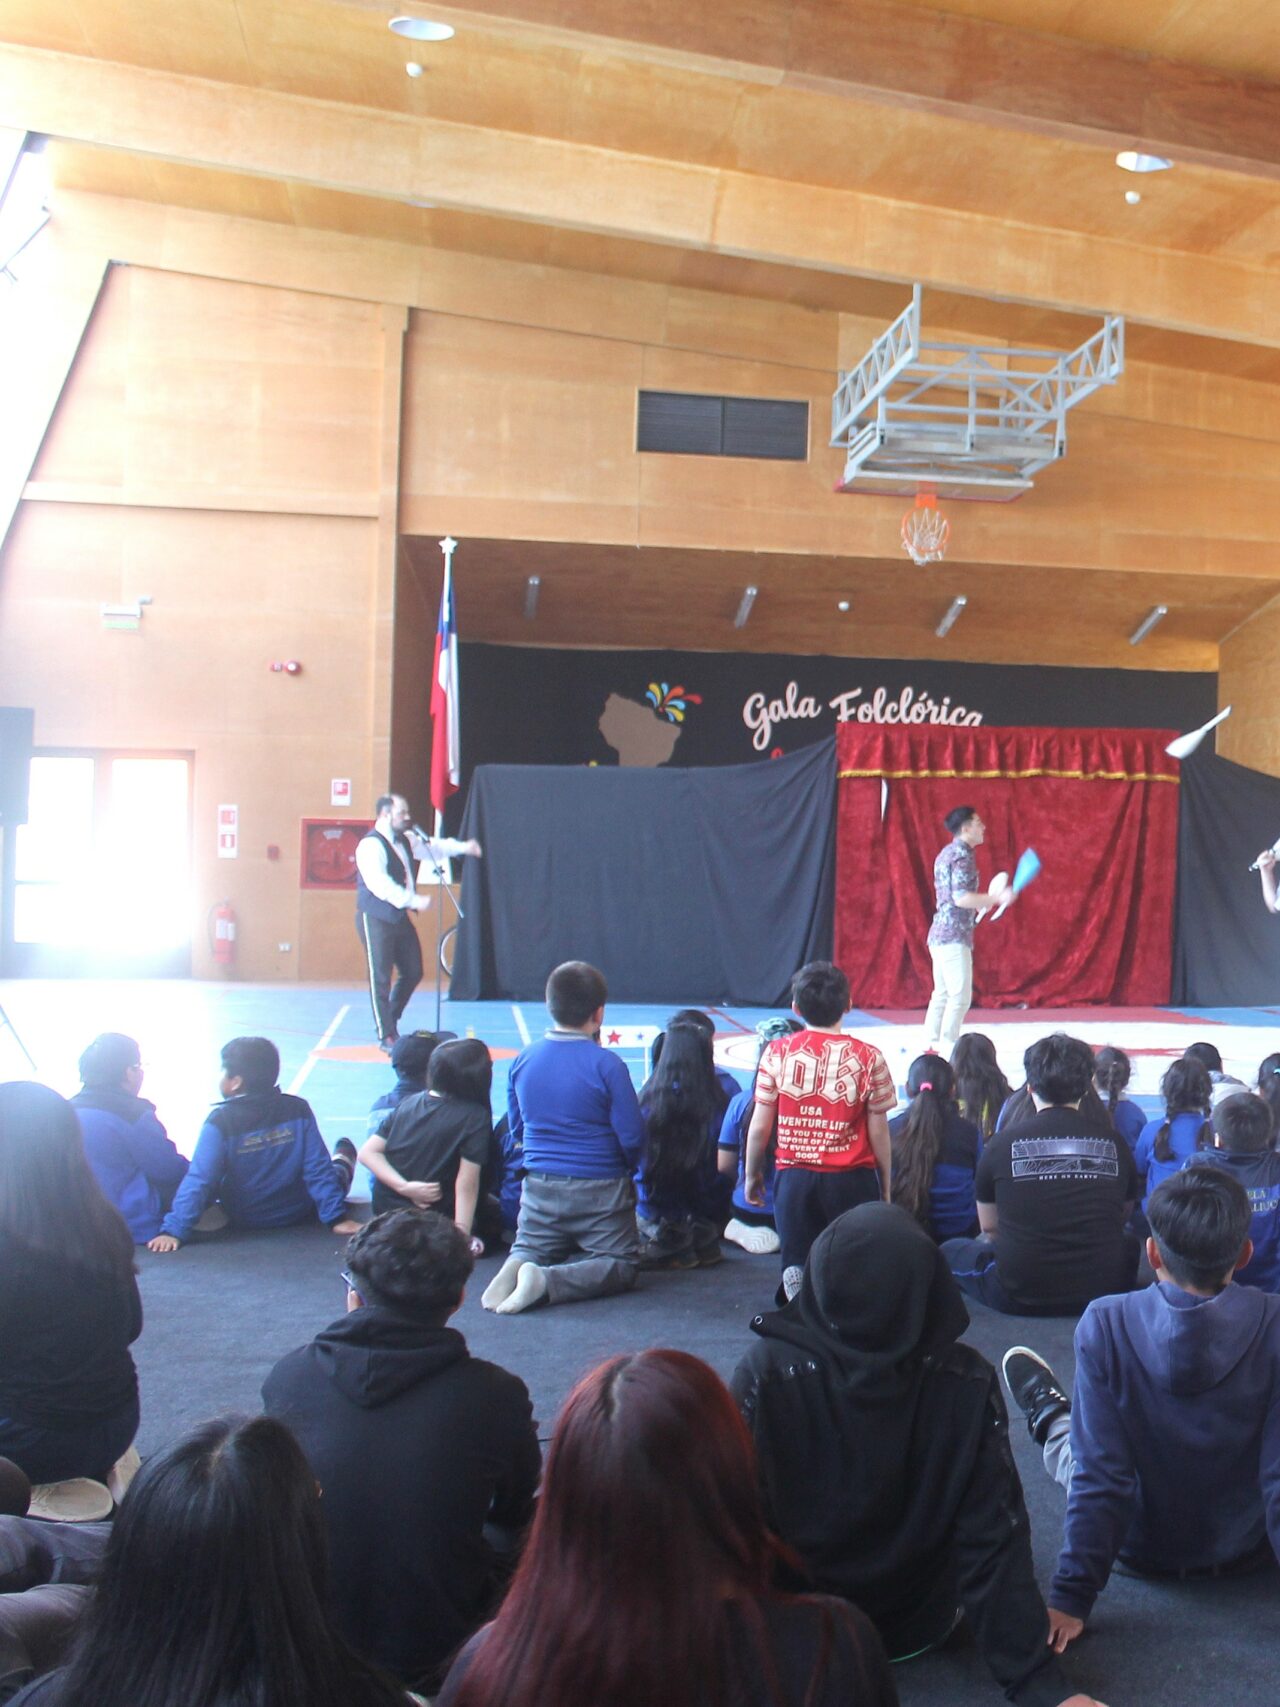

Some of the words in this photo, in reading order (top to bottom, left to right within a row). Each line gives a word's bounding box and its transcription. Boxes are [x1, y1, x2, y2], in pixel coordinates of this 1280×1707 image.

[742, 681, 821, 750] Gala
[829, 686, 983, 727] Folclórica
[800, 1106, 822, 1116] USA
[793, 1130, 810, 1138] YOU
[818, 1144, 850, 1153] MMENT
